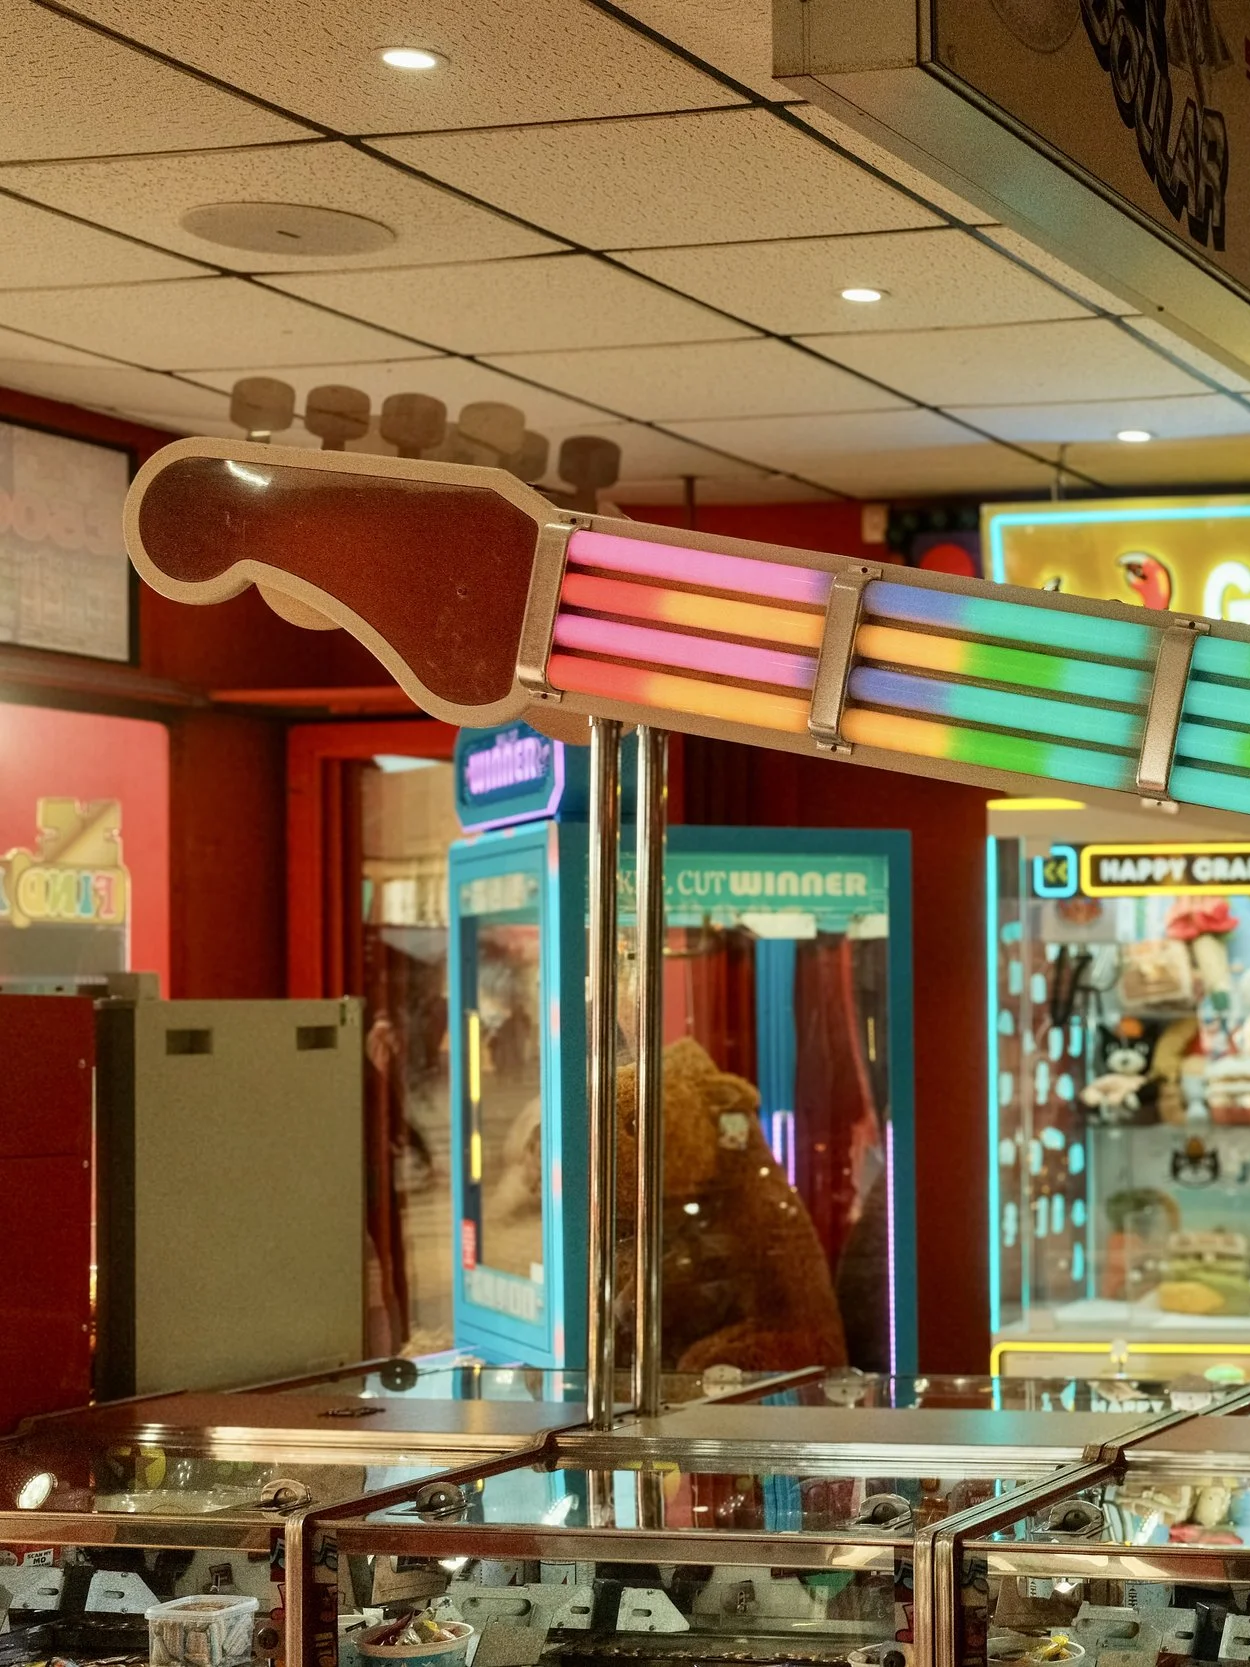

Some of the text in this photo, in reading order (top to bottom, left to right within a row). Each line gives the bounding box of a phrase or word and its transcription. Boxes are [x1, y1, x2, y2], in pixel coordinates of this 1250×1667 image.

[1099, 856, 1187, 883] HAPPY
[677, 870, 727, 896] CUT
[728, 870, 869, 897] WINNER
